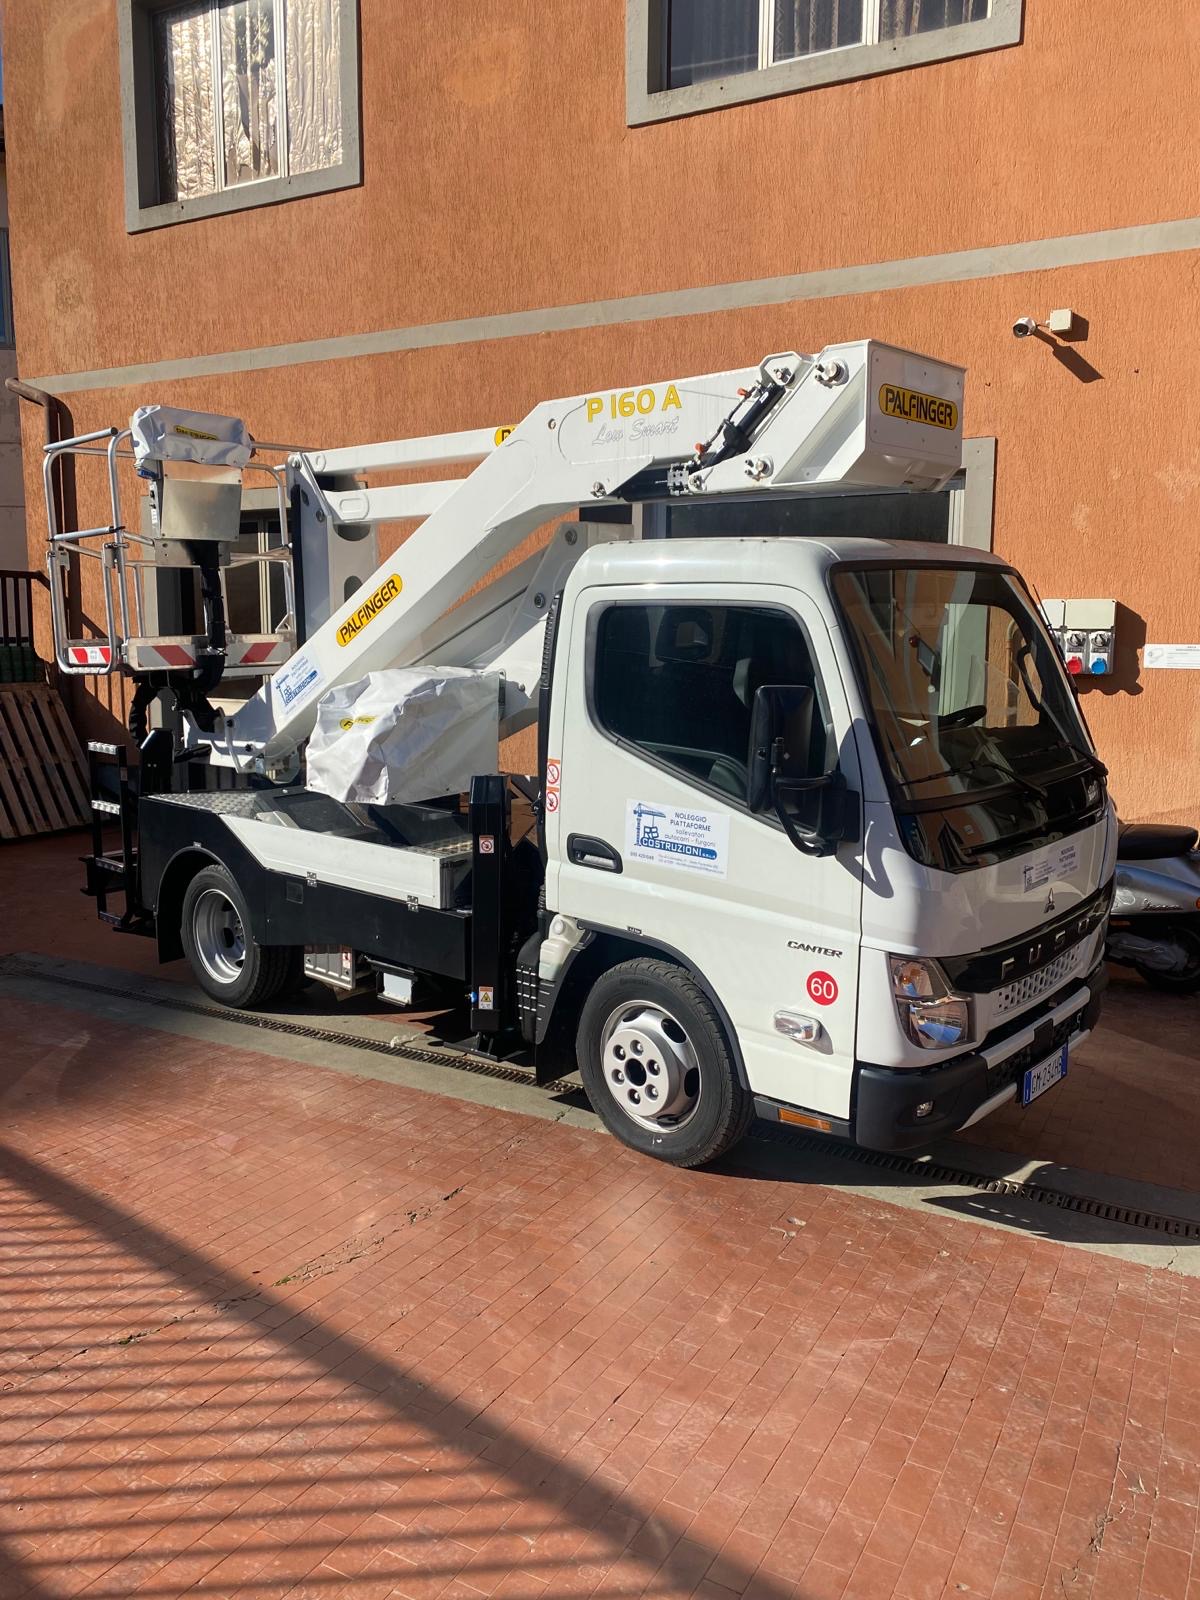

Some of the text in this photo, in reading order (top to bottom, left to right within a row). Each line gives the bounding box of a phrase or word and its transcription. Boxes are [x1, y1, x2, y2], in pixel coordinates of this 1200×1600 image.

[587, 384, 682, 422] P 160 A
[885, 387, 953, 427] PALFINGER
[628, 416, 680, 441] Smart
[338, 577, 399, 643] PALFINGER
[670, 819, 712, 832] PIATTAFORME
[674, 812, 707, 823] NOLEGGIO
[642, 837, 702, 857] COSTRUZIONI
[787, 940, 843, 958] CANTER
[810, 977, 835, 999] 60
